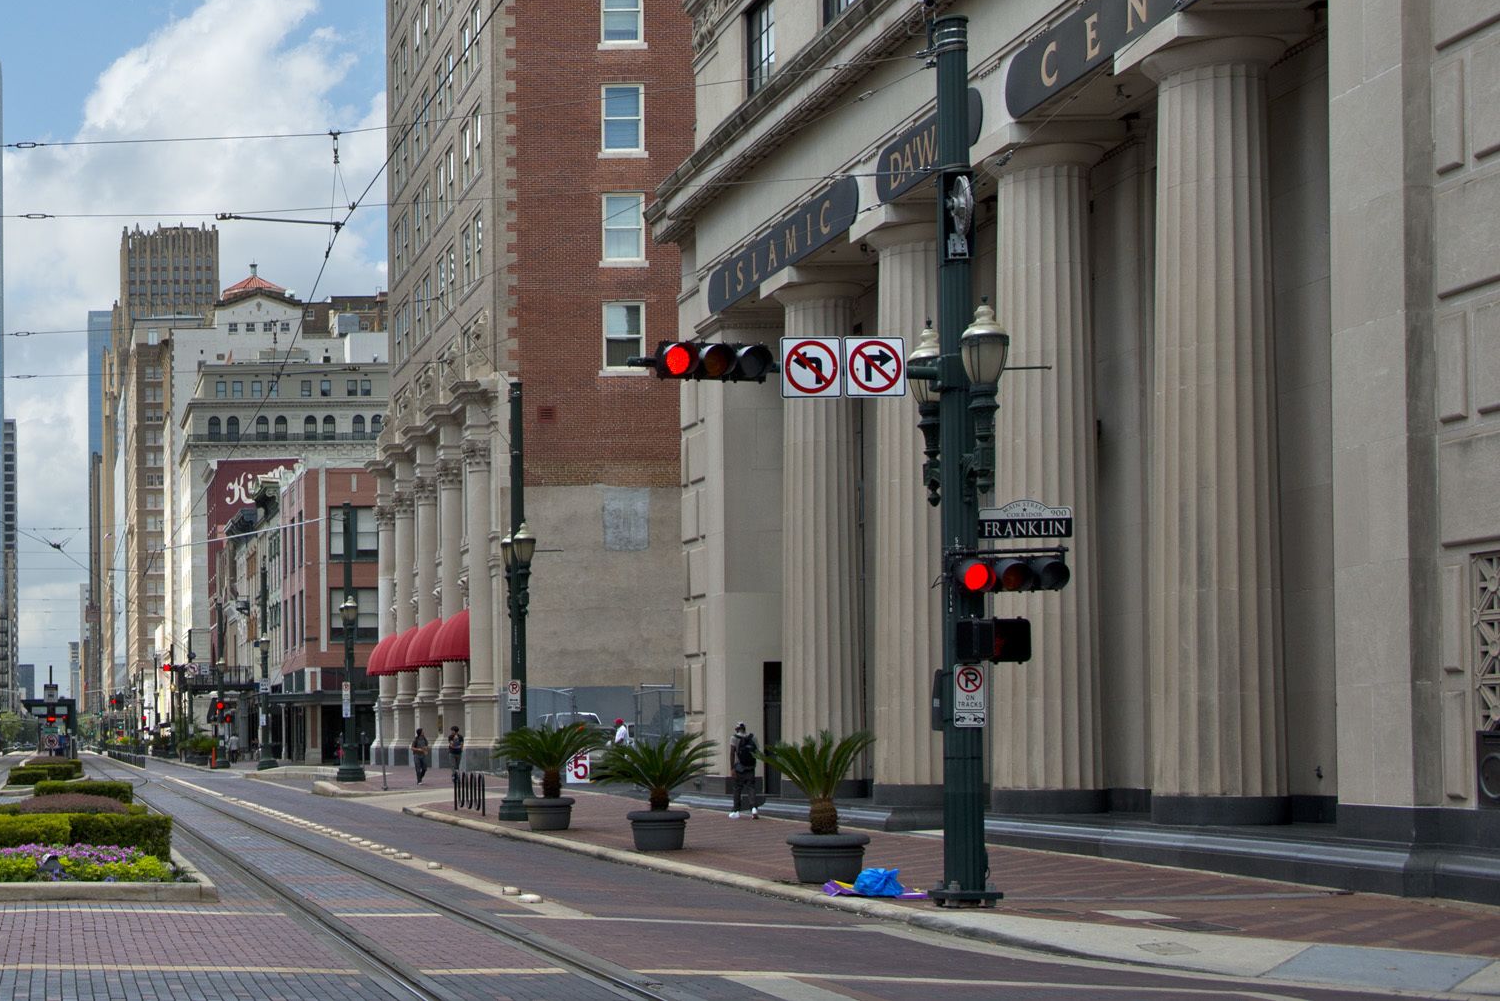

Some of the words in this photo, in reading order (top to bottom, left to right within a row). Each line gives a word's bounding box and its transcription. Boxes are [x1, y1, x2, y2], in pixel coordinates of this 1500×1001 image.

[724, 199, 832, 300] ISLAMIC
[889, 124, 938, 191] DA'W
[1050, 509, 1067, 517] 900
[984, 520, 1067, 537] FRANKLIN
[567, 754, 589, 780] $5
